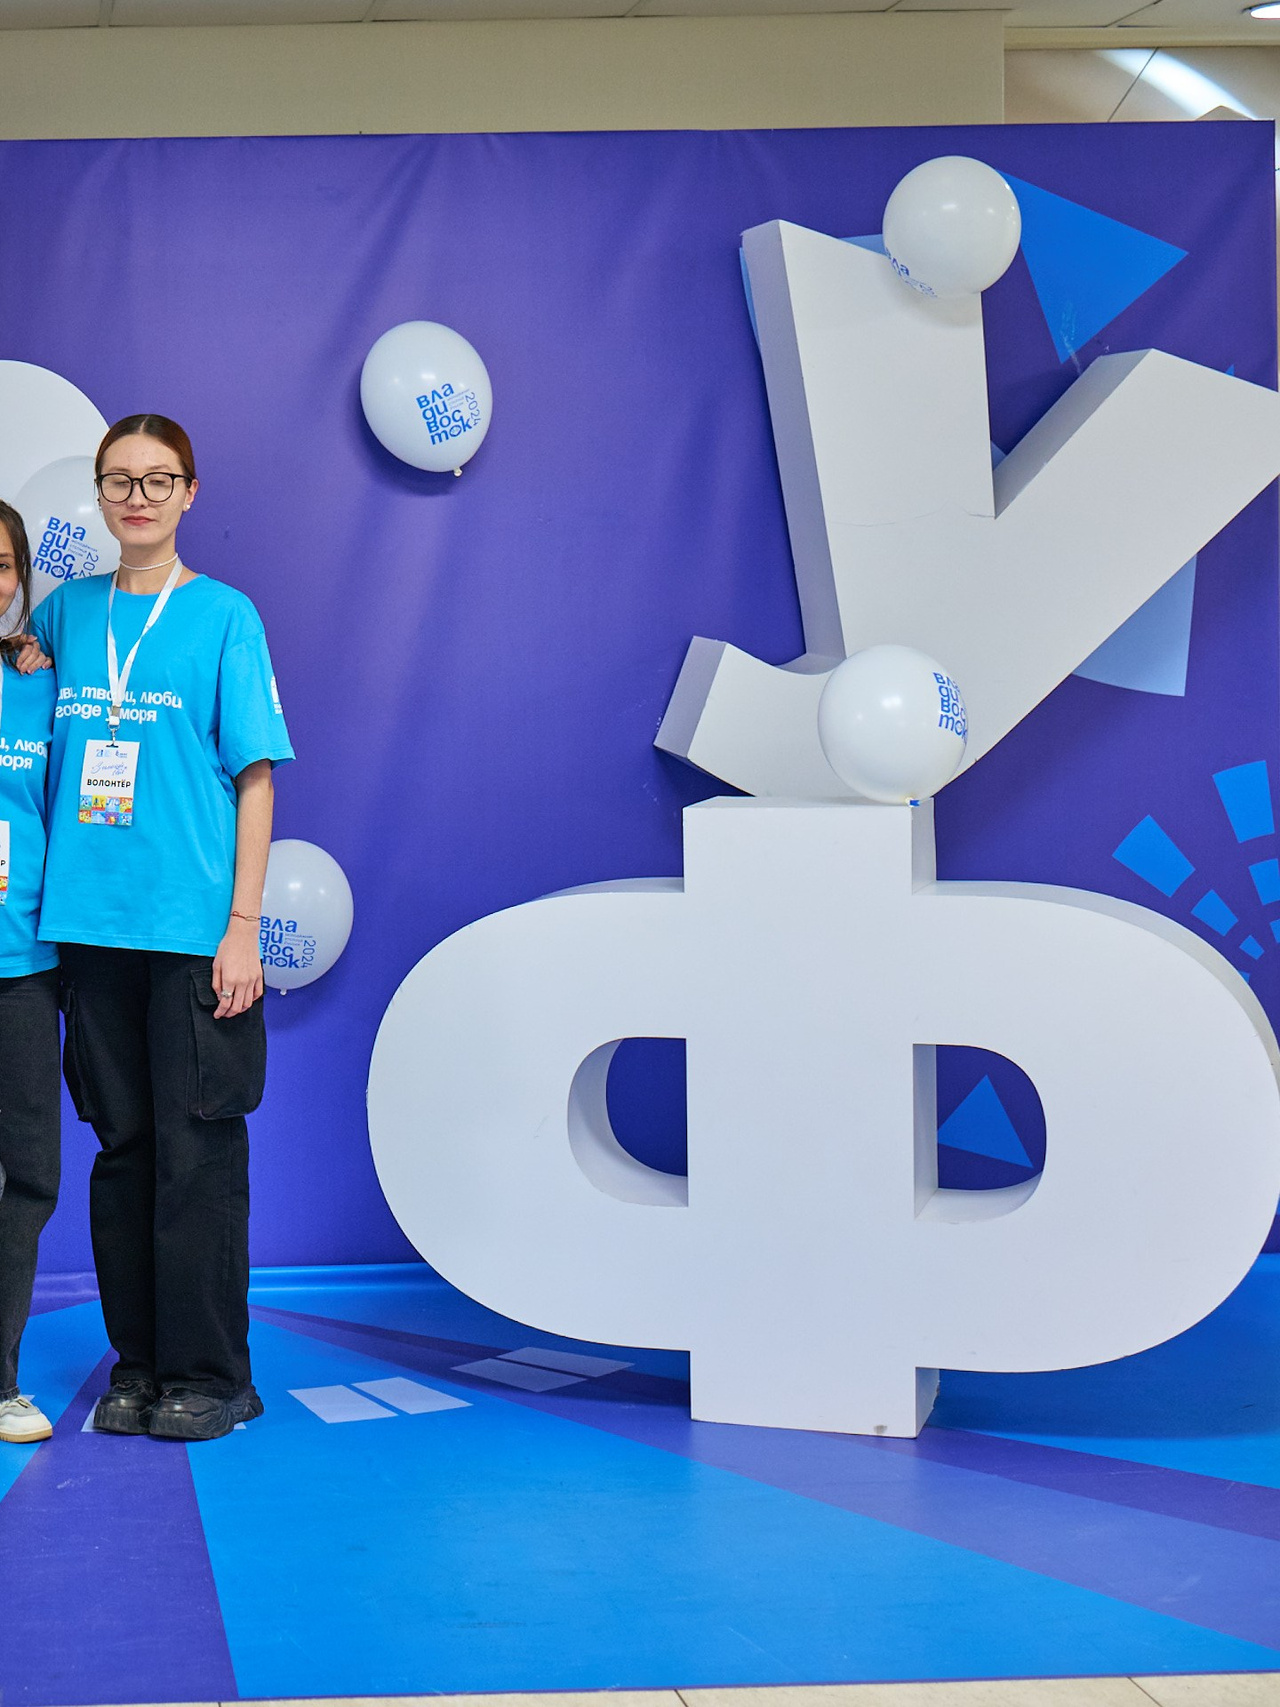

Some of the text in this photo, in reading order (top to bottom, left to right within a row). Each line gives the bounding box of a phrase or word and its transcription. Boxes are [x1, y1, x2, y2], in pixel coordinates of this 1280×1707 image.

[465, 392, 481, 426] 2024
[79, 552, 99, 577] 202
[81, 686, 136, 705] твои,
[140, 691, 182, 709] люби
[119, 707, 158, 724] моря
[301, 940, 316, 969] 2024
[367, 797, 1280, 1438] Ф
